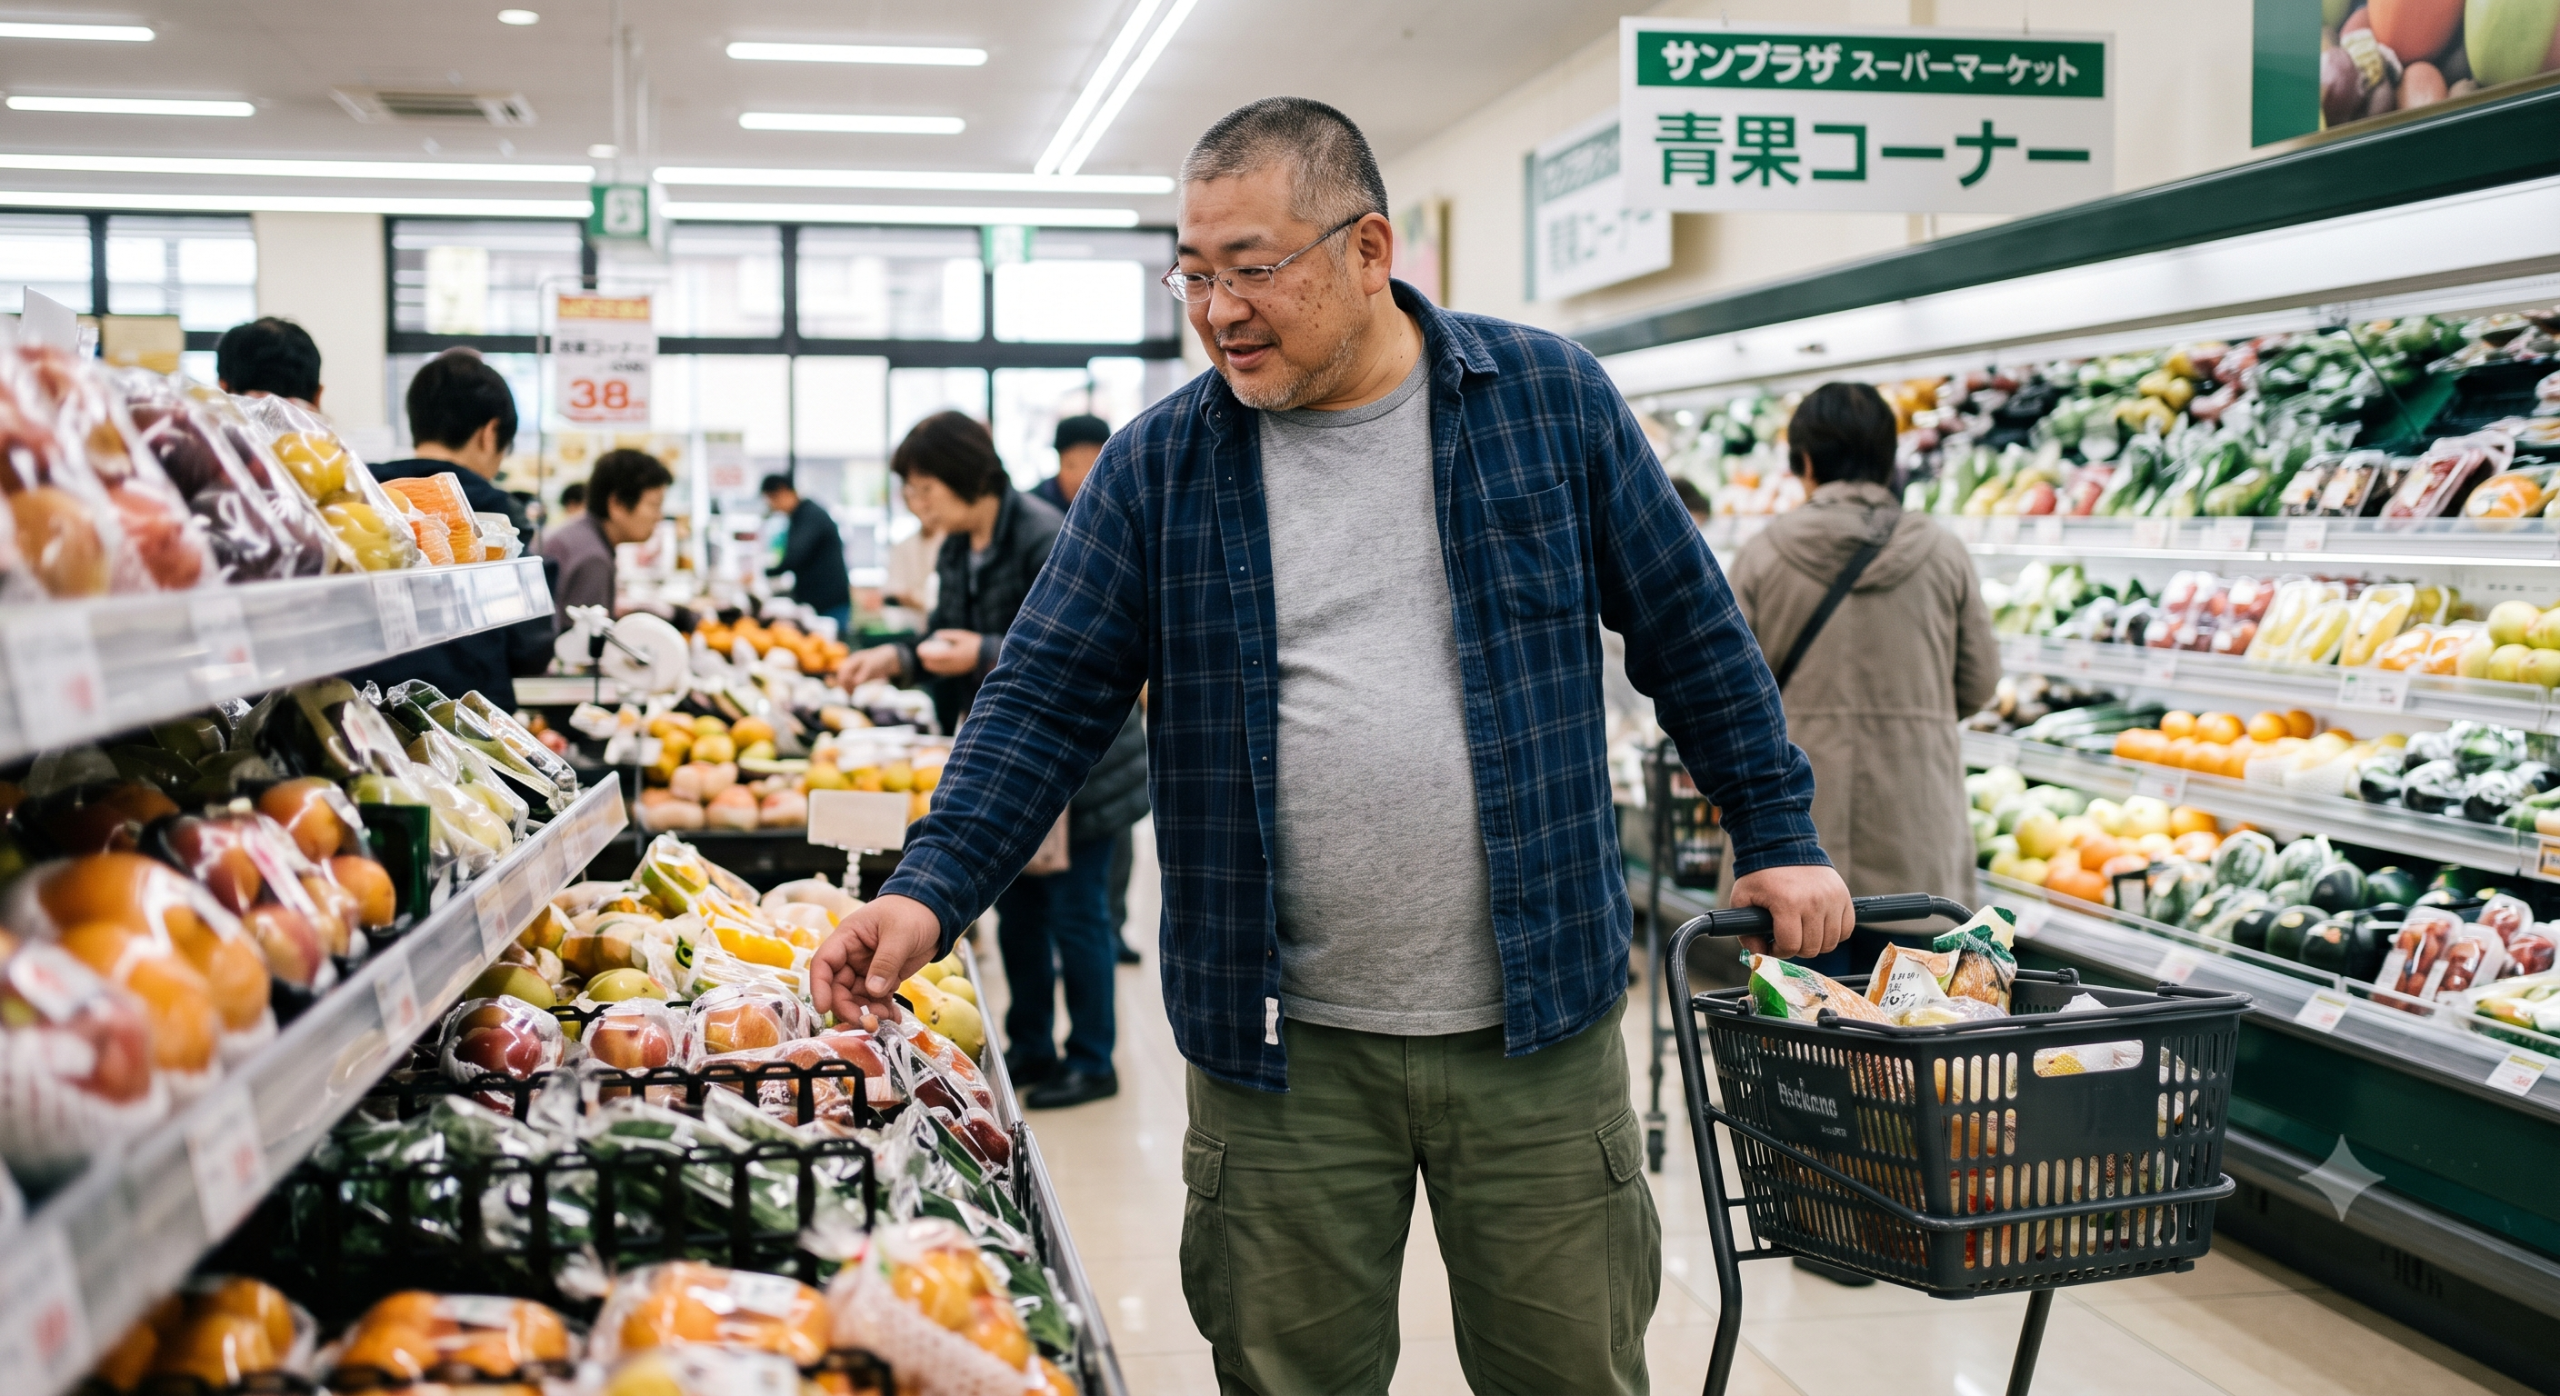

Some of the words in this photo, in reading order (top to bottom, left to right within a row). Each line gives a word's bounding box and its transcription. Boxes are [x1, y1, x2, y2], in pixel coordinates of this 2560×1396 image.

[1662, 41, 1842, 85] サンプラザ
[1851, 51, 2079, 87] スーパーマーケット
[1654, 112, 2092, 190] 青果コーナー
[570, 378, 630, 410] 38
